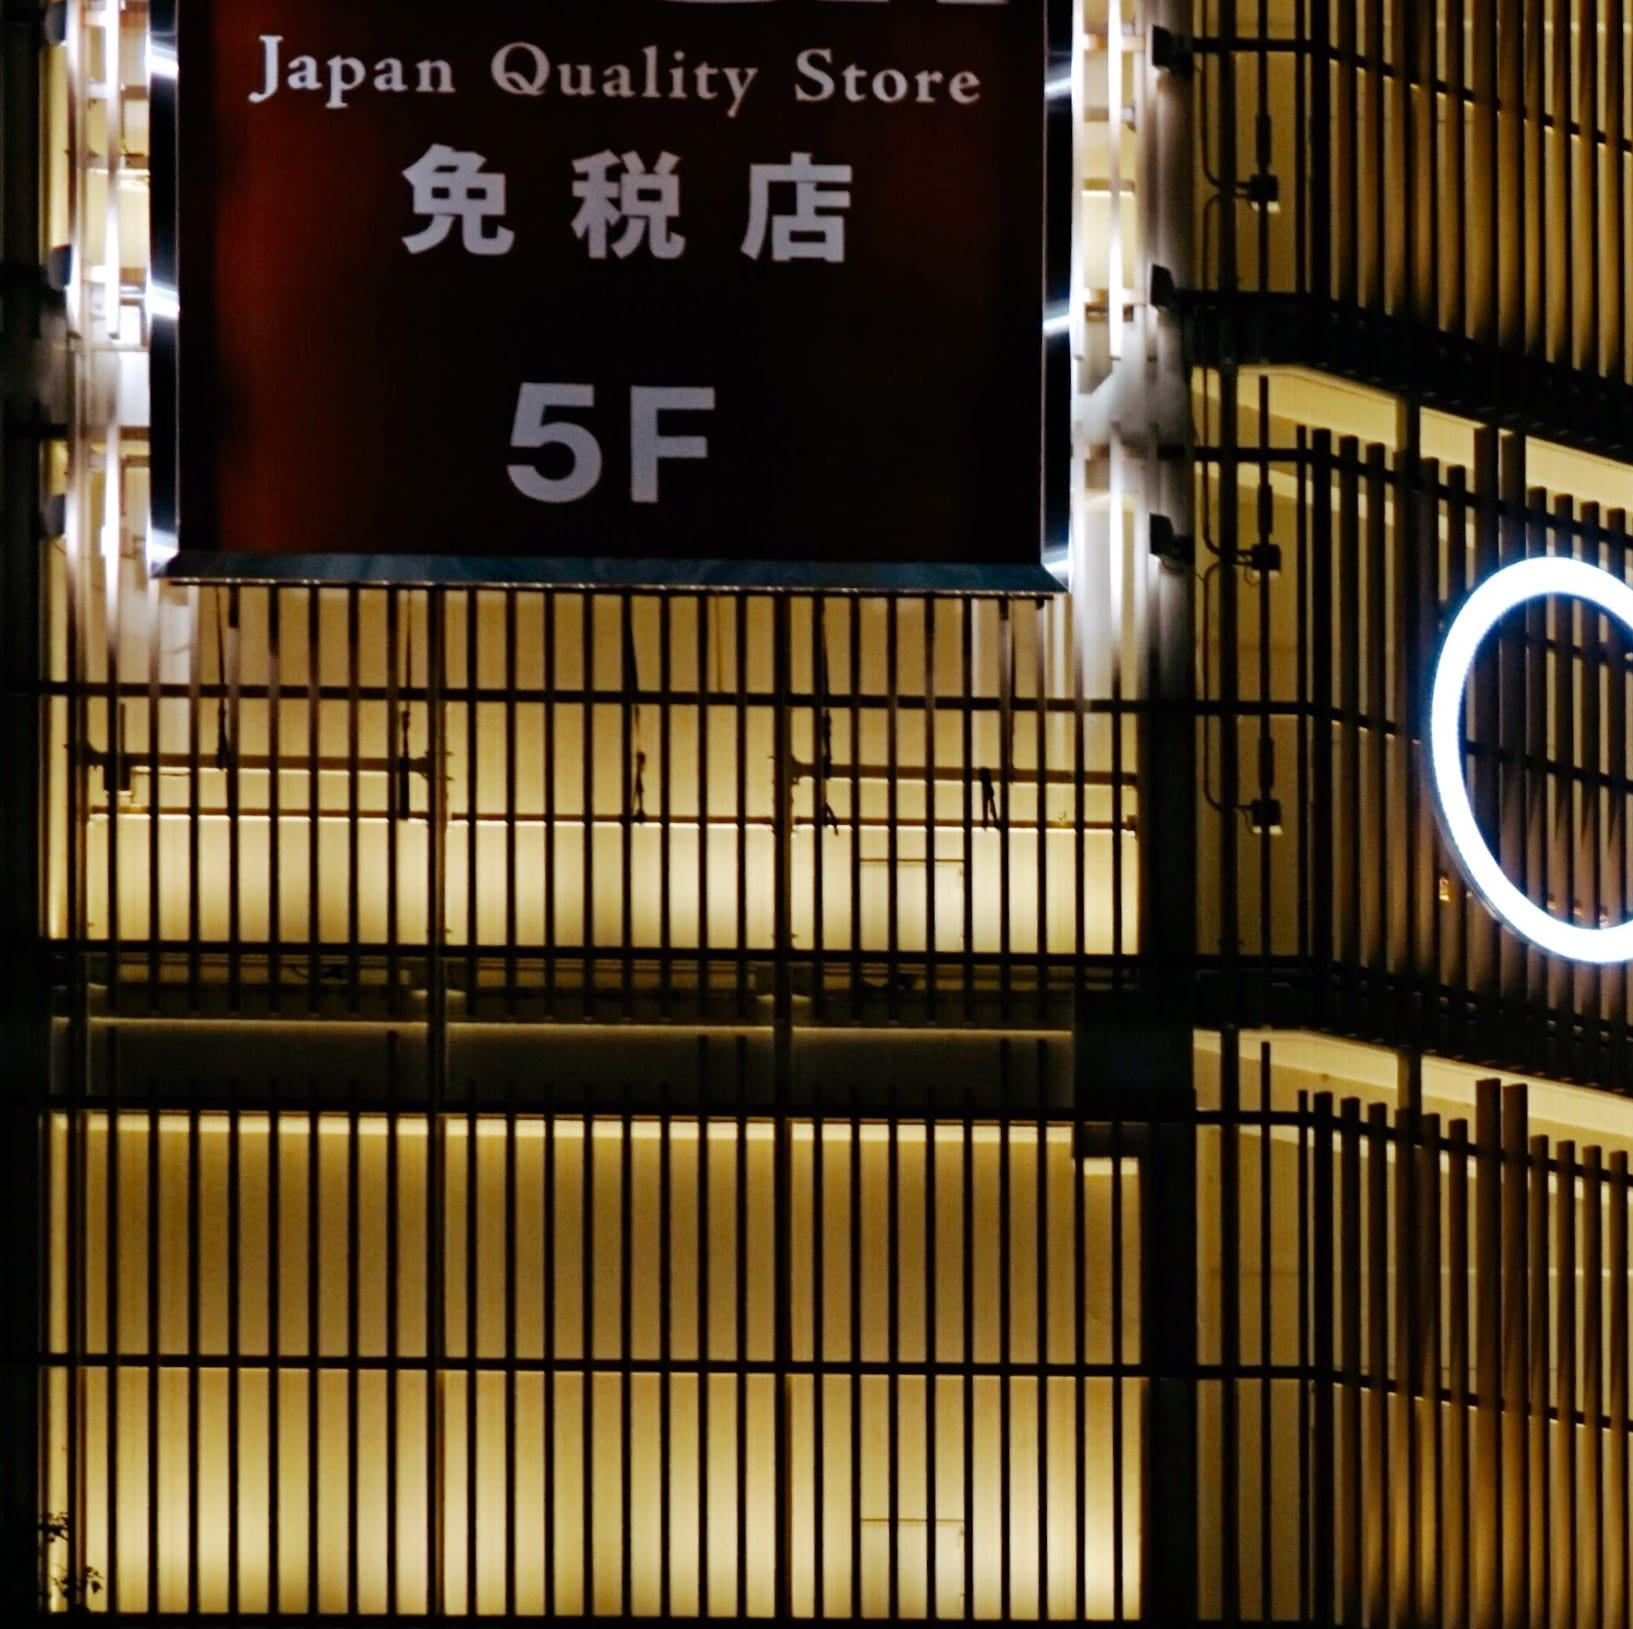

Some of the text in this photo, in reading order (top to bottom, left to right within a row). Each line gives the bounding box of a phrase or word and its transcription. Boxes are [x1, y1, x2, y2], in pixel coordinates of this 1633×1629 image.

[249, 34, 980, 118] Japan Quality Store
[402, 143, 852, 263] 免税店
[507, 382, 716, 503] 5F
